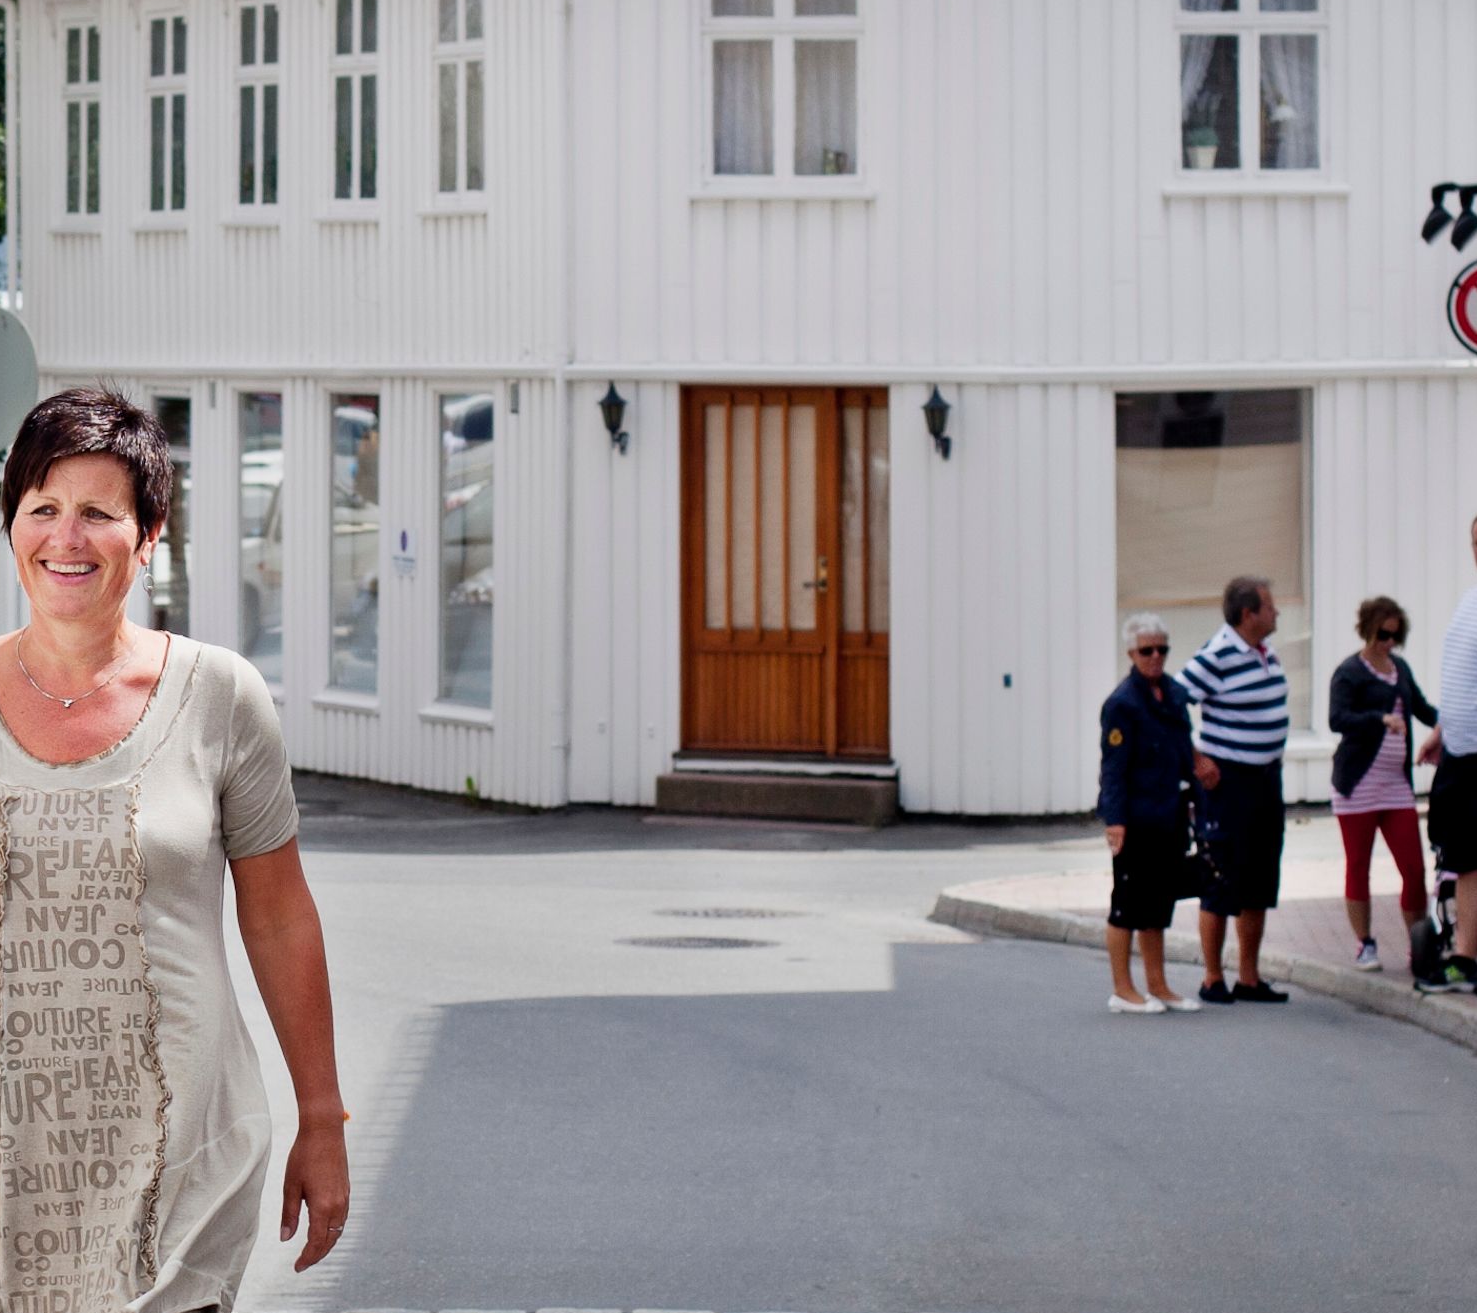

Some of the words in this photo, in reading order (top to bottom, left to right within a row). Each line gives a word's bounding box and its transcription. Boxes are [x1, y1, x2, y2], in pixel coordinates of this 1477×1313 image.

[38, 817, 110, 834] JEAN
[70, 884, 133, 901] JEAN
[25, 903, 107, 936] JEAN
[8, 980, 64, 998] JEAN
[6, 1006, 113, 1038] OUTURE
[121, 1013, 145, 1029] JE
[51, 1035, 111, 1052] JEAN
[2, 1070, 76, 1125] URE
[92, 1088, 140, 1103] JEAN
[86, 1104, 141, 1121] JEAN
[47, 1125, 122, 1157] JEAN
[2, 1159, 135, 1200] COUTURE
[34, 1199, 85, 1217] JEAN
[14, 1222, 117, 1256] COUTURE
